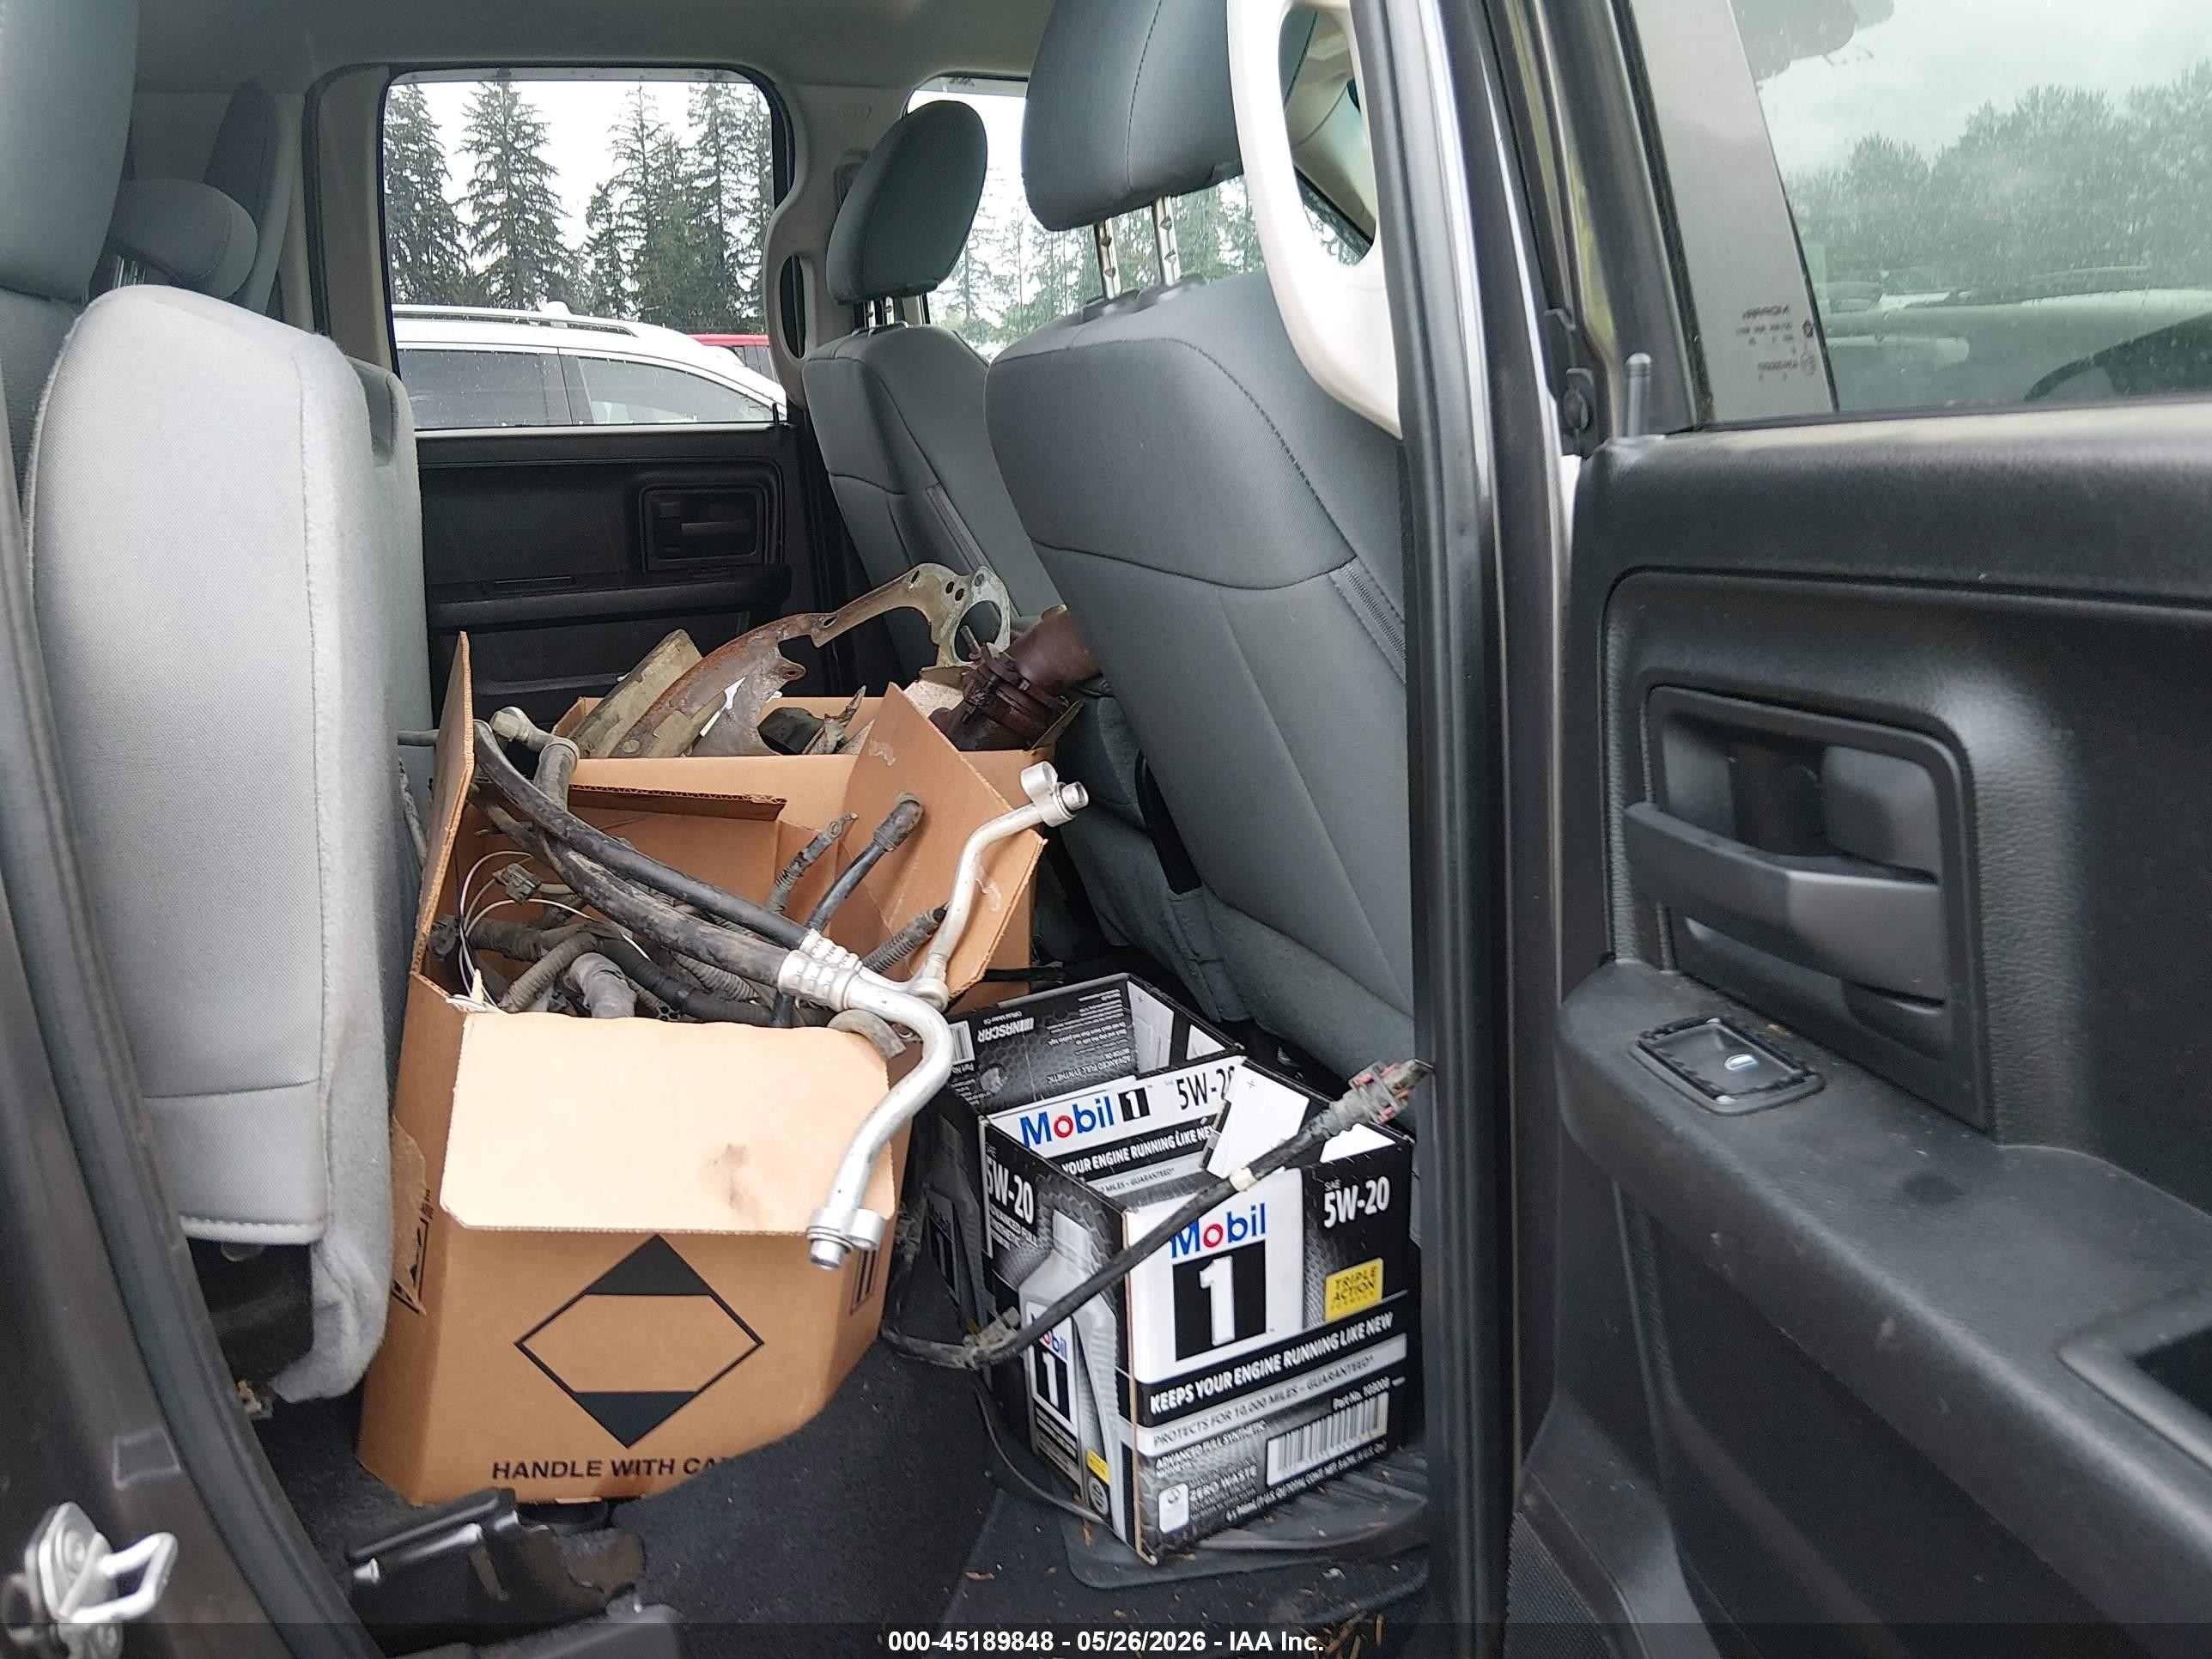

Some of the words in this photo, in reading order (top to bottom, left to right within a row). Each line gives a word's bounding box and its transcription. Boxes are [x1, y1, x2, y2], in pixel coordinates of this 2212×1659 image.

[977, 1018, 1025, 1042] NASCAR
[1020, 1096, 1114, 1148] Mobil
[1061, 1155, 1091, 1176] YOUR
[1092, 1146, 1129, 1170] ENGINE
[1129, 1136, 1176, 1159] RUNNING
[1175, 1129, 1197, 1148] LIKE
[1323, 1176, 1390, 1229] 5W-20
[1169, 1203, 1267, 1260] Mobil
[1331, 1279, 1377, 1303] ACTION
[1334, 1267, 1378, 1288] TRIPLE
[1200, 1255, 1236, 1347] 1
[1150, 1383, 1194, 1416] KEEPS
[1196, 1371, 1233, 1400] YOUR
[1233, 1354, 1282, 1386] ENGINE
[1283, 1333, 1340, 1368] RUNNING
[1340, 1322, 1367, 1346] LIKE
[1366, 1311, 1394, 1338] NEW
[1152, 1420, 1208, 1448] PROTECTS
[1210, 1410, 1231, 1430] FOR
[492, 1461, 602, 1479] HANDLE
[611, 1458, 675, 1477] WITH
[683, 1457, 728, 1474] CA
[1189, 1480, 1219, 1502] ZERO
[1219, 1465, 1257, 1492] WASTE
